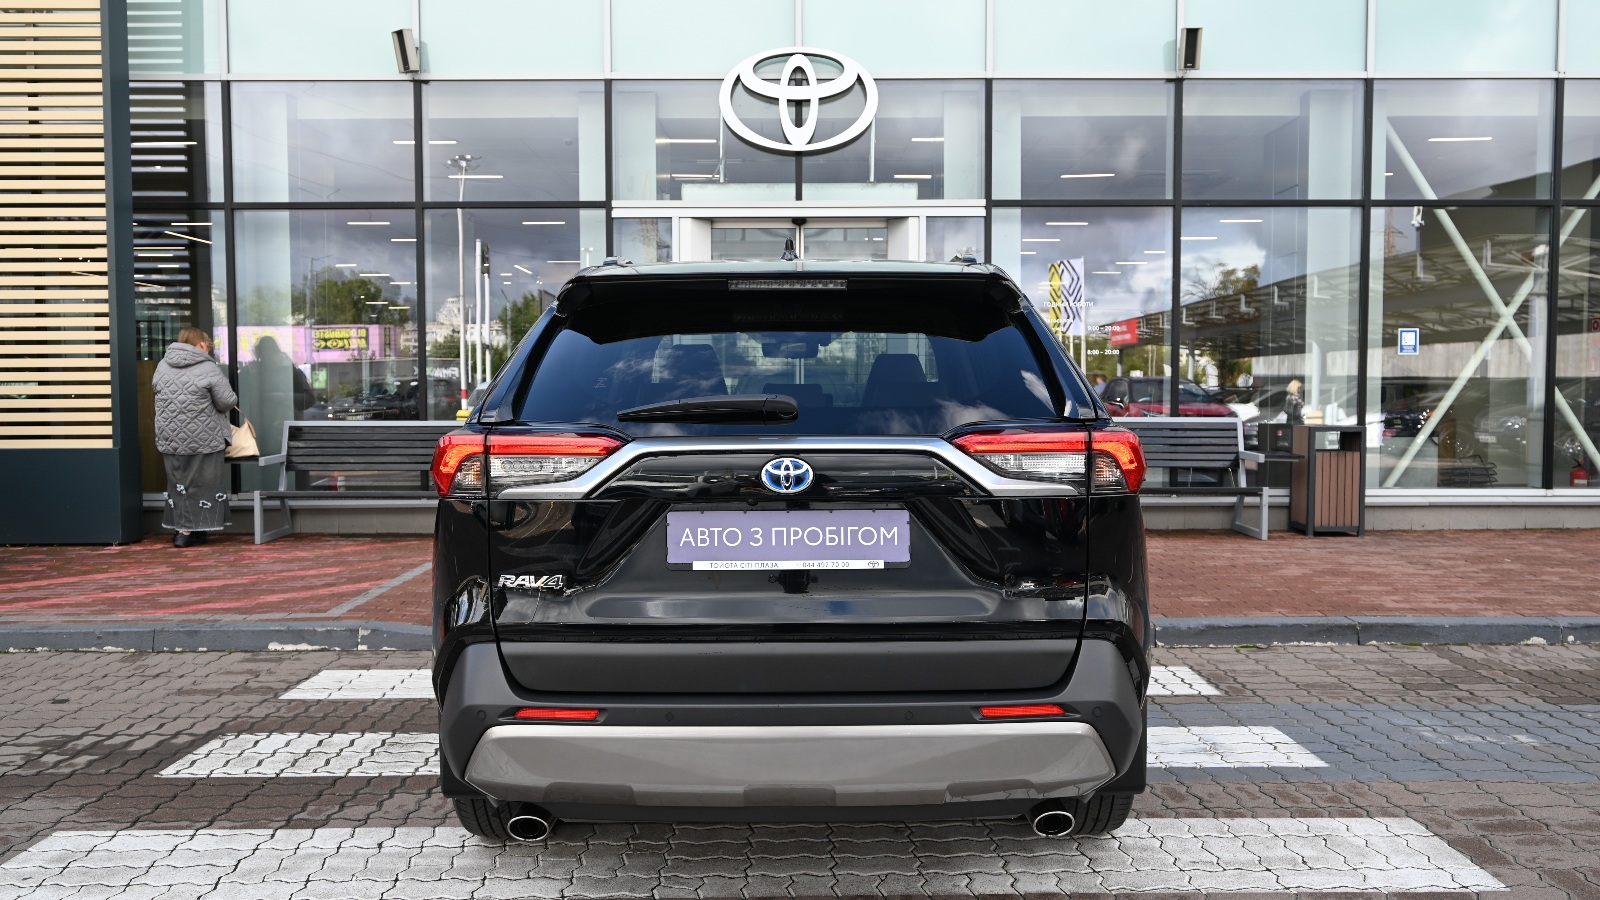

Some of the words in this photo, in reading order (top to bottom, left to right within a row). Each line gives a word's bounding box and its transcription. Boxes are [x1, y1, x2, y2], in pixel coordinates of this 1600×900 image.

[679, 527, 742, 547] АВТО
[749, 527, 763, 547] З
[771, 526, 899, 547] ПРОБІГОМ
[498, 574, 563, 589] RAV4
